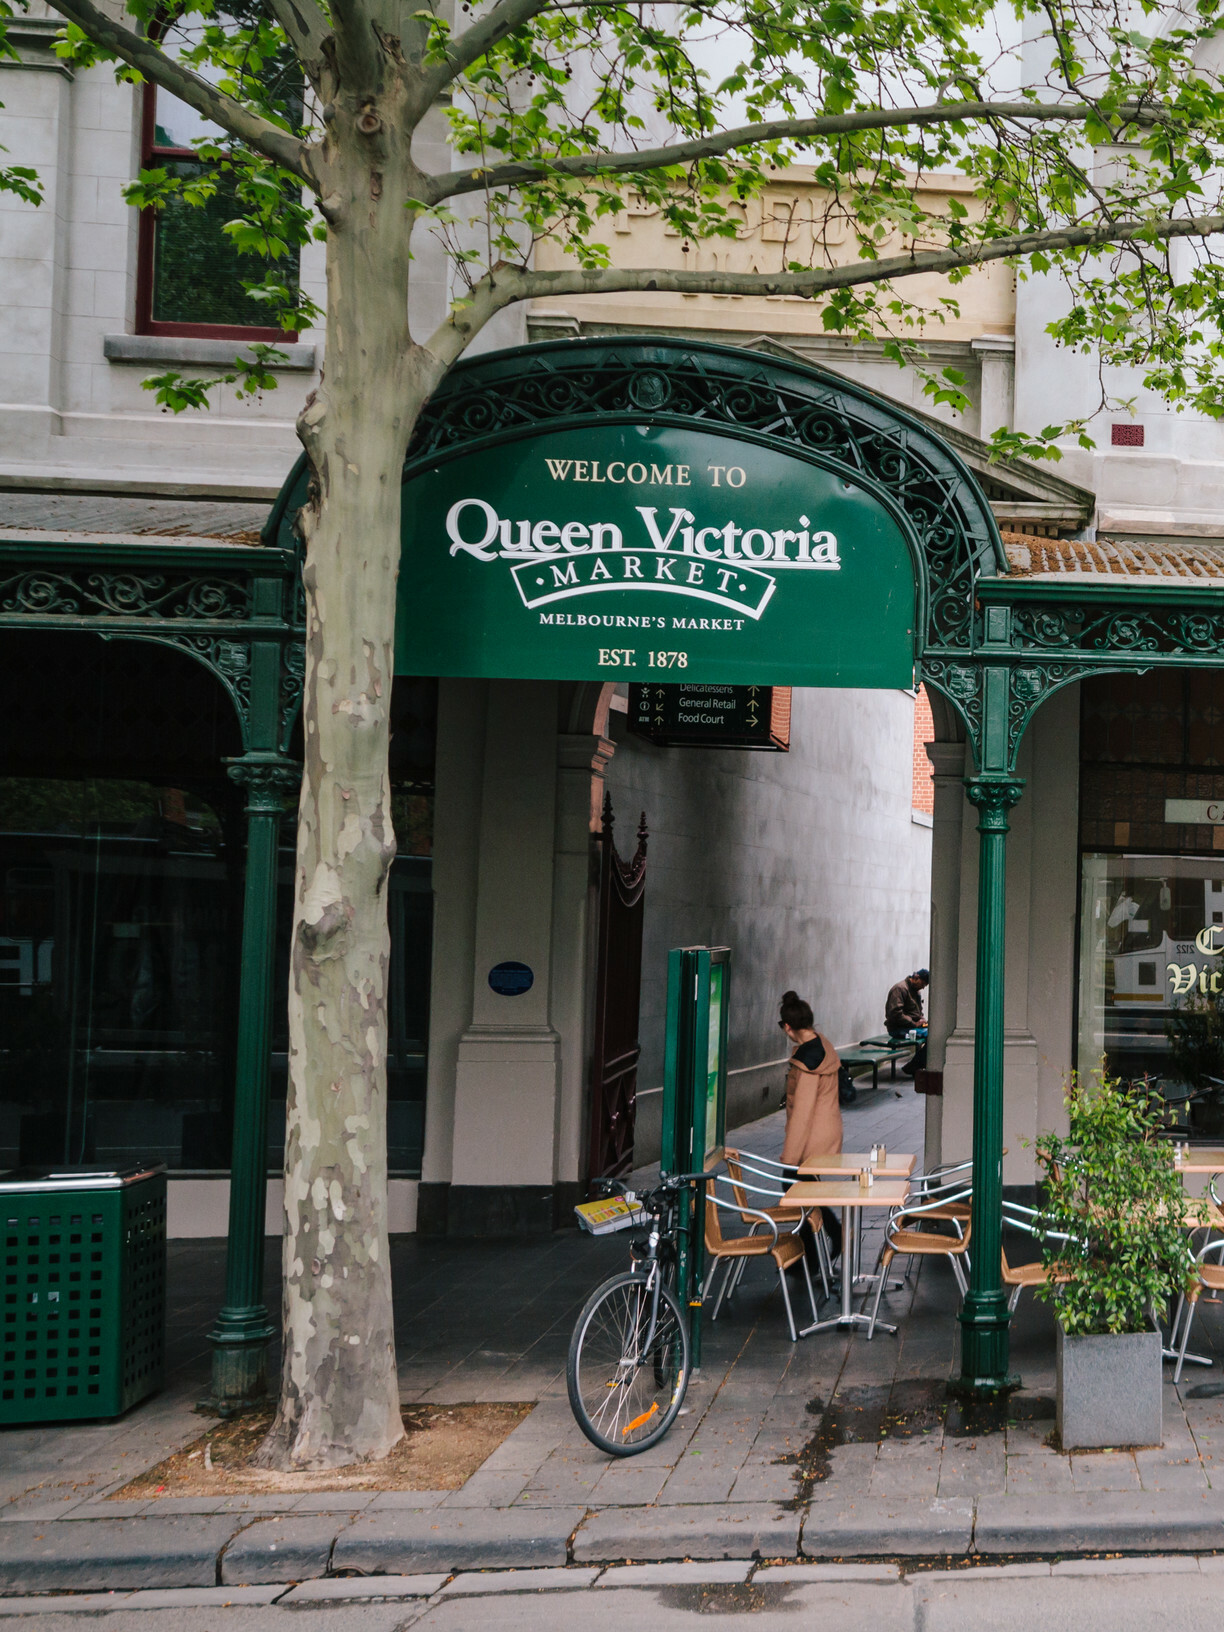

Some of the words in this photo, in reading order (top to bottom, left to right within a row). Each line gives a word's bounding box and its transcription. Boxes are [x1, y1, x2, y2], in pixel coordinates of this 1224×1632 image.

[545, 458, 692, 486] WELCOME
[708, 466, 747, 489] TO
[446, 498, 624, 562] Queen
[635, 506, 841, 564] Victoria
[549, 555, 738, 593] MARKET
[539, 613, 666, 628] MELBOURNE'S
[672, 618, 745, 631] MARKET
[598, 649, 637, 667] EST.
[647, 650, 689, 669] 1878
[679, 684, 733, 694] Delicatessens
[679, 697, 711, 708] General
[713, 699, 736, 709] Retail
[678, 713, 699, 723] Food
[701, 713, 724, 724] Court
